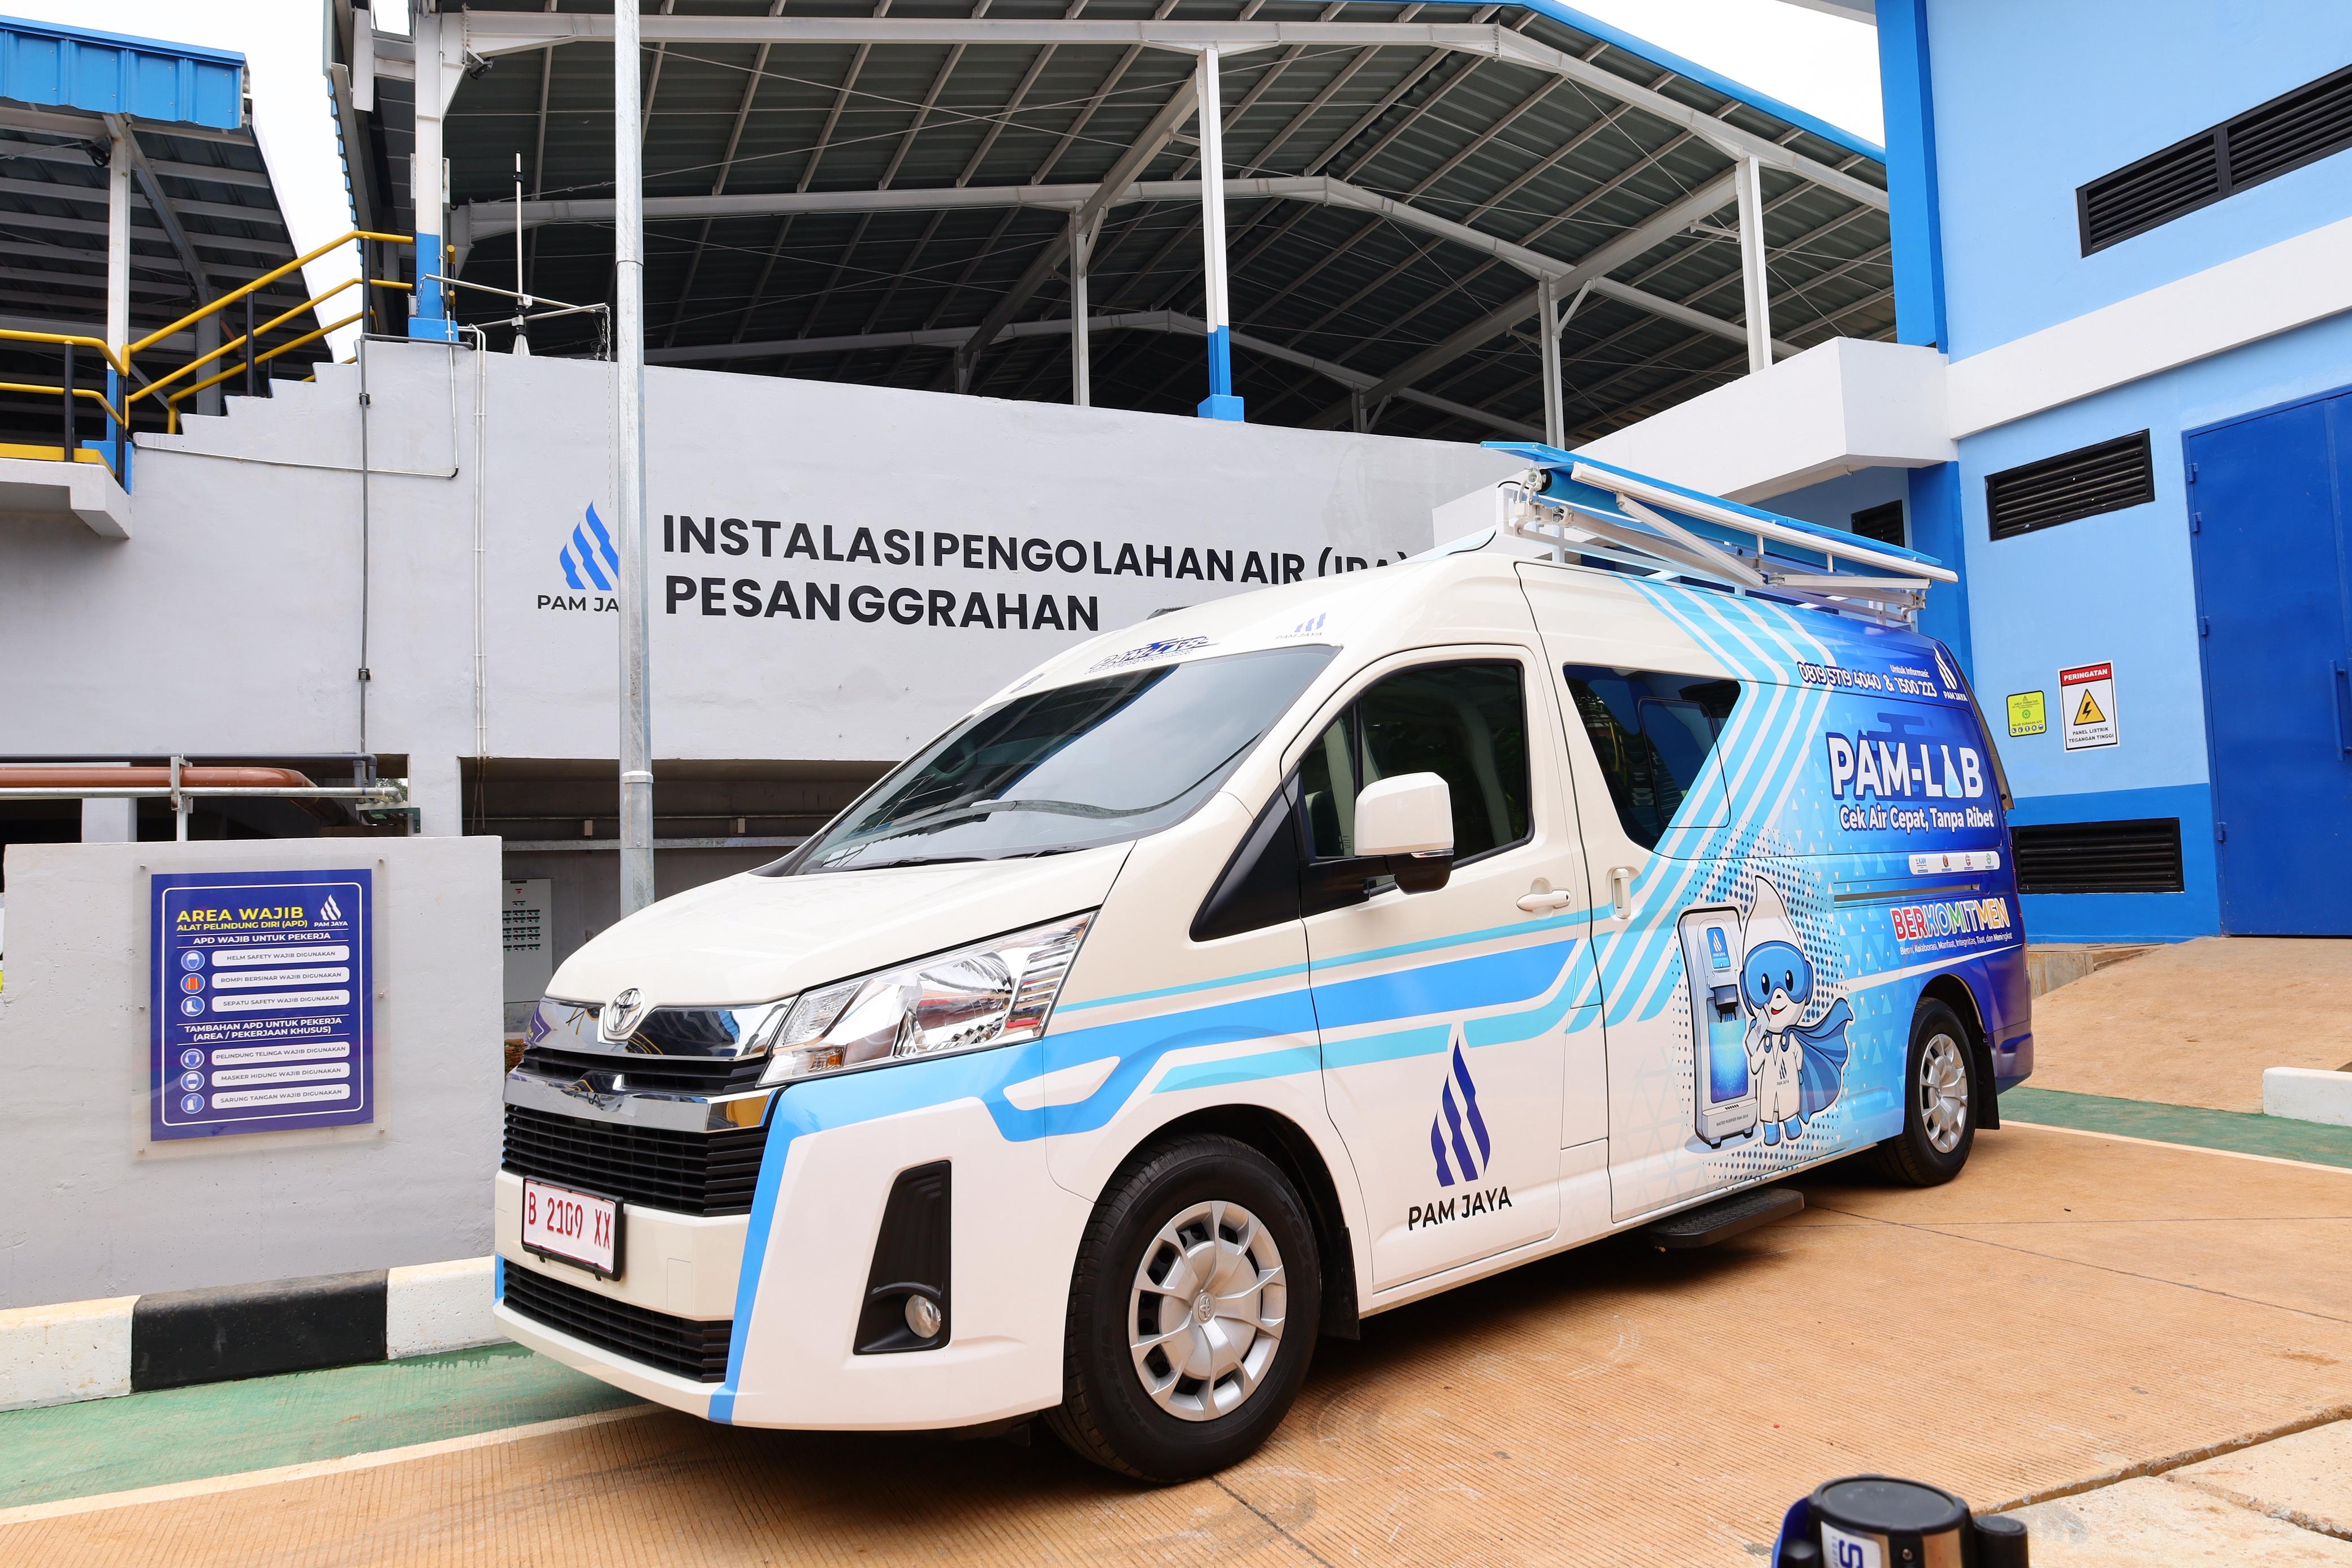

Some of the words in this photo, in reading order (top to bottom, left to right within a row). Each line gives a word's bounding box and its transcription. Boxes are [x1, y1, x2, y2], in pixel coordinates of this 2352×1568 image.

[664, 514, 924, 566] INSTALASI
[933, 532, 1233, 582] PENGOLAHAN
[1240, 551, 1305, 584] AIR
[538, 595, 586, 611] PAM
[666, 575, 1098, 631] PESANGGRAHAN
[1890, 665, 1906, 675] Untuk
[2063, 668, 2108, 681] PERINGATAN
[1853, 671, 1882, 690] 4040
[1883, 674, 1895, 692] &
[1893, 677, 1919, 695] 1500
[1918, 680, 1938, 697] 223
[1943, 691, 1956, 699] PAM
[1955, 692, 1968, 701] JAYA
[1840, 805, 1867, 830] Cek
[1869, 804, 1887, 829] Air
[1890, 807, 1929, 833] Cepat,
[1929, 807, 1965, 833] Tanpa
[1965, 805, 1995, 828] Ribet
[176, 908, 232, 922] AREA
[238, 906, 304, 920] WAJIB
[1890, 897, 2011, 942] BERKOMITMEN
[176, 923, 202, 932] ALAT
[203, 921, 259, 931] PELINDUNG
[282, 919, 308, 929] (APD)
[193, 936, 215, 945] APD
[217, 935, 250, 944] WAJIB
[252, 934, 287, 943] UNTUK
[288, 932, 331, 941] PEKERJA
[1914, 942, 1939, 953] Kolaborasi,
[1938, 940, 1956, 950] Manfaat,
[1956, 937, 1977, 948] Integritas,
[1977, 935, 1986, 944] Taat,
[1994, 932, 2013, 943] Meningkat
[184, 1023, 241, 1033] TAMBAHAN
[243, 1021, 263, 1030] APD
[266, 1020, 299, 1029] UNTUK
[300, 1017, 342, 1026] PEKERJA
[193, 1032, 224, 1042] (AREA
[225, 1030, 230, 1040] /
[231, 1028, 288, 1038] PEKERJAAN
[290, 1026, 332, 1036] KHUSUS)
[1408, 1197, 1455, 1231] PAM
[1461, 1185, 1513, 1219] JAYA
[528, 1191, 537, 1225] B
[547, 1197, 583, 1239] 2109
[594, 1208, 611, 1250] XX
